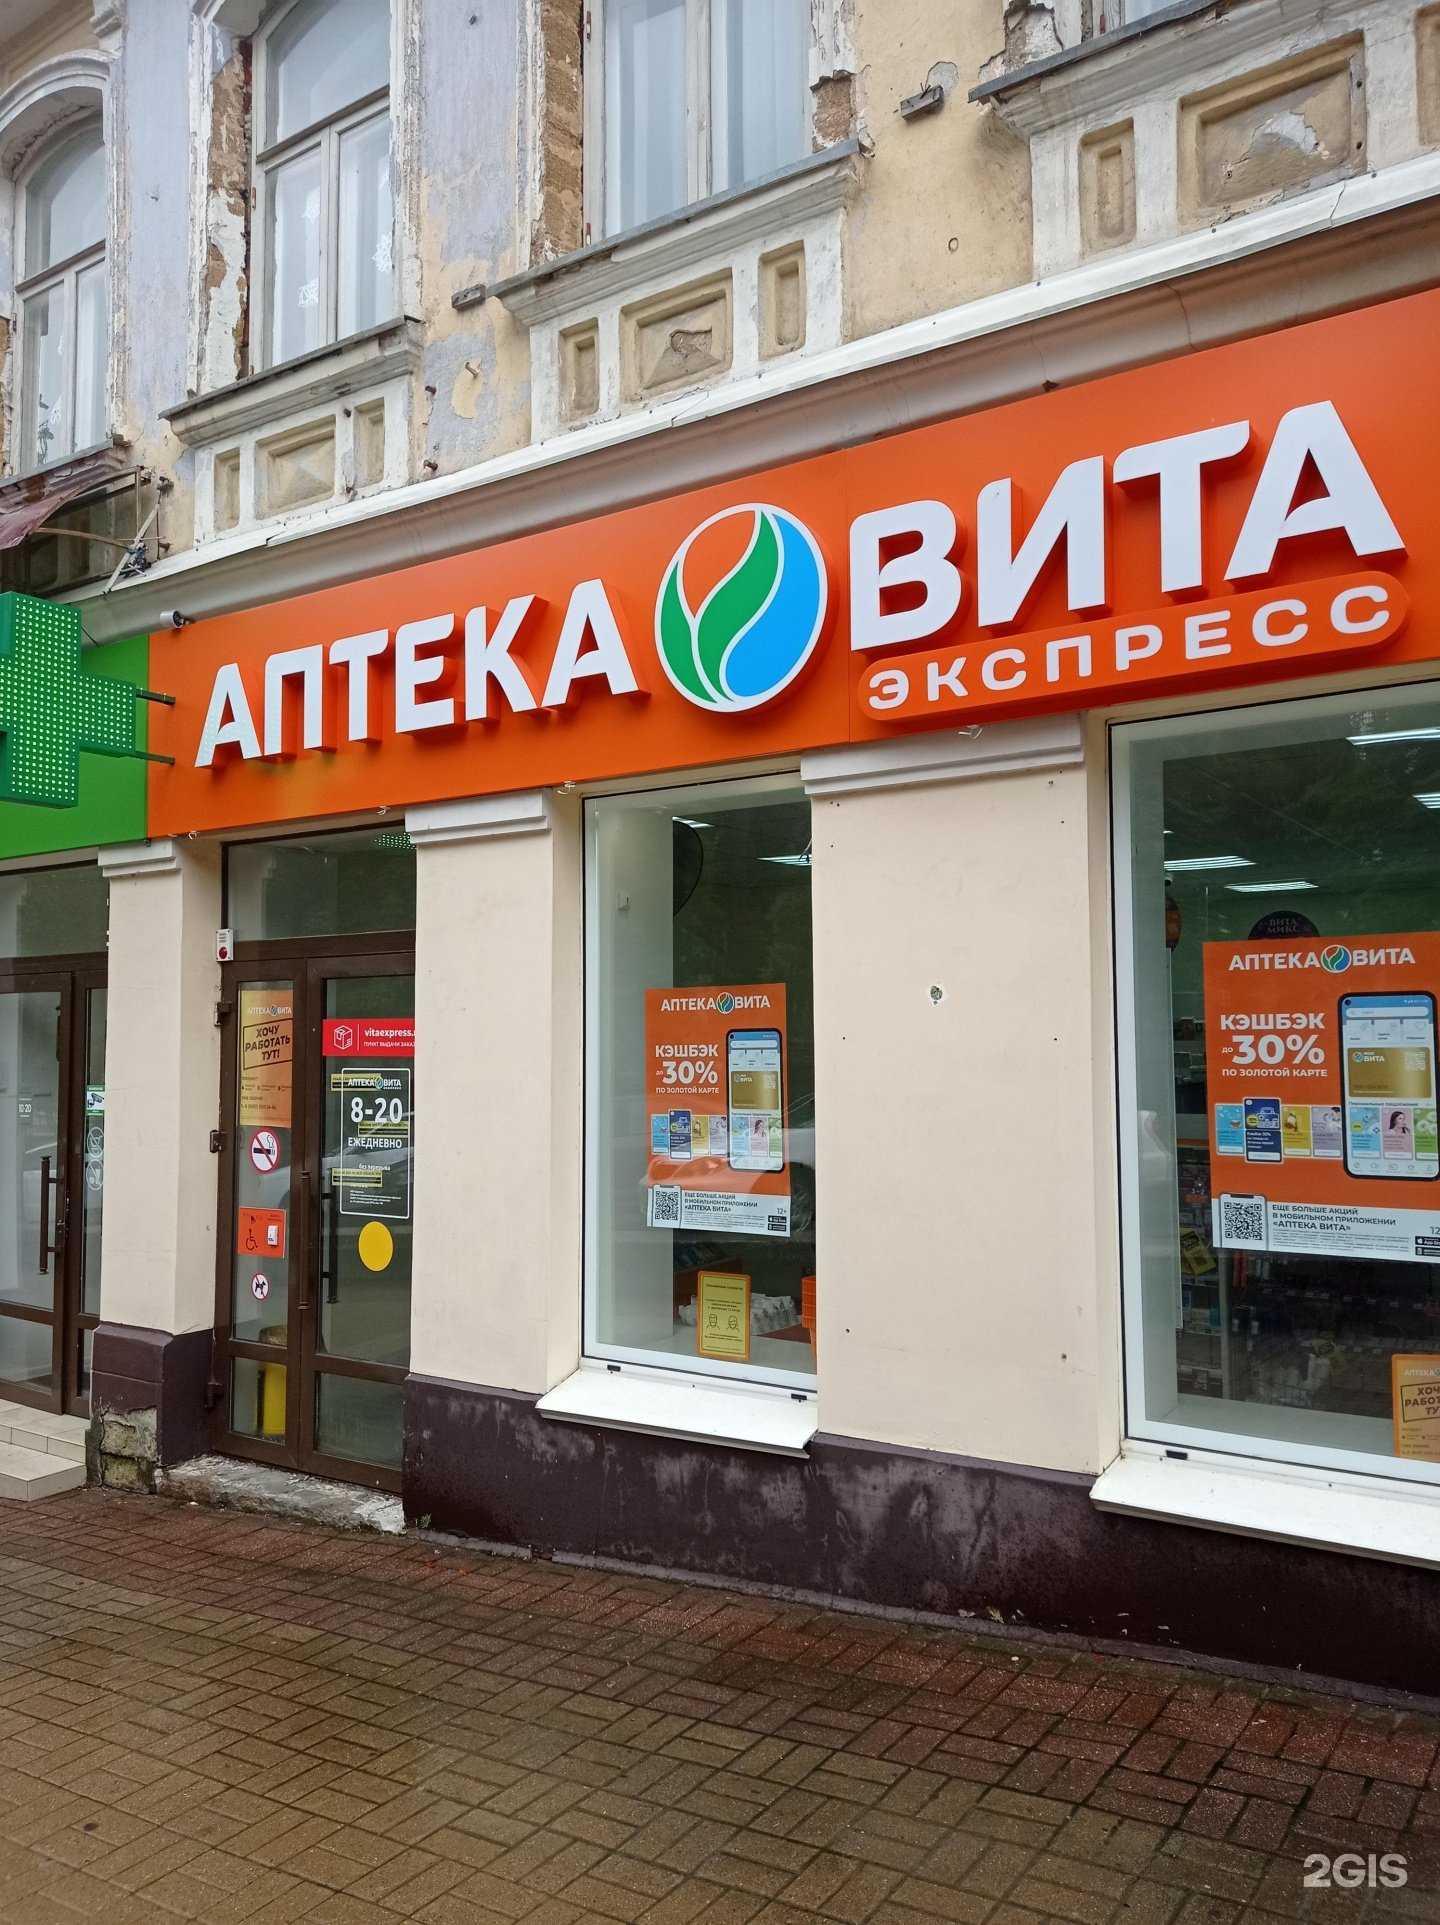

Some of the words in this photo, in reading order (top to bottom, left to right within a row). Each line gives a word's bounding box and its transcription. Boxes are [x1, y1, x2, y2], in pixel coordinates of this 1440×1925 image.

[194, 577, 640, 769] АПТЕКА
[848, 399, 1407, 652] ВИТА
[867, 584, 1391, 711] ЭКСПРЕСС
[1228, 951, 1321, 971] АПТЕКА
[1352, 947, 1416, 966] ВИТА
[660, 997, 717, 1012] АПТЕКА
[734, 995, 771, 1009] ВИТА
[1219, 1012, 1326, 1030] КЭШБЭК
[256, 1025, 280, 1038] ХОЧУ
[245, 1035, 291, 1052] РАБОТАТЬ
[1231, 1034, 1325, 1065] 30%
[261, 1049, 280, 1061] ТУТ!
[655, 1044, 719, 1057] КЭШБЭК
[662, 1060, 719, 1084] 30%
[1222, 1068, 1237, 1076] ПО
[1239, 1066, 1290, 1077] ЗОЛОТОЙ
[1293, 1068, 1328, 1077] КАРТЕ
[347, 1078, 376, 1086] АПТЕКА
[383, 1079, 401, 1087] ВИТА
[667, 1086, 697, 1094] ЗОЛОТОЙ
[350, 1097, 403, 1124] 8-20
[347, 1137, 403, 1149] ЕЖЕДНЕВНО
[1292, 1205, 1327, 1213] БОЛЬШЕ
[1329, 1207, 1359, 1215] АКЦИЙ
[1279, 1213, 1334, 1222] МОБИЛЬНОМ
[1335, 1216, 1397, 1225] ПРИЛОЖЕНИИ
[1272, 1220, 1317, 1230] «АПТЕКА
[1319, 1222, 1351, 1232] ВИТА»
